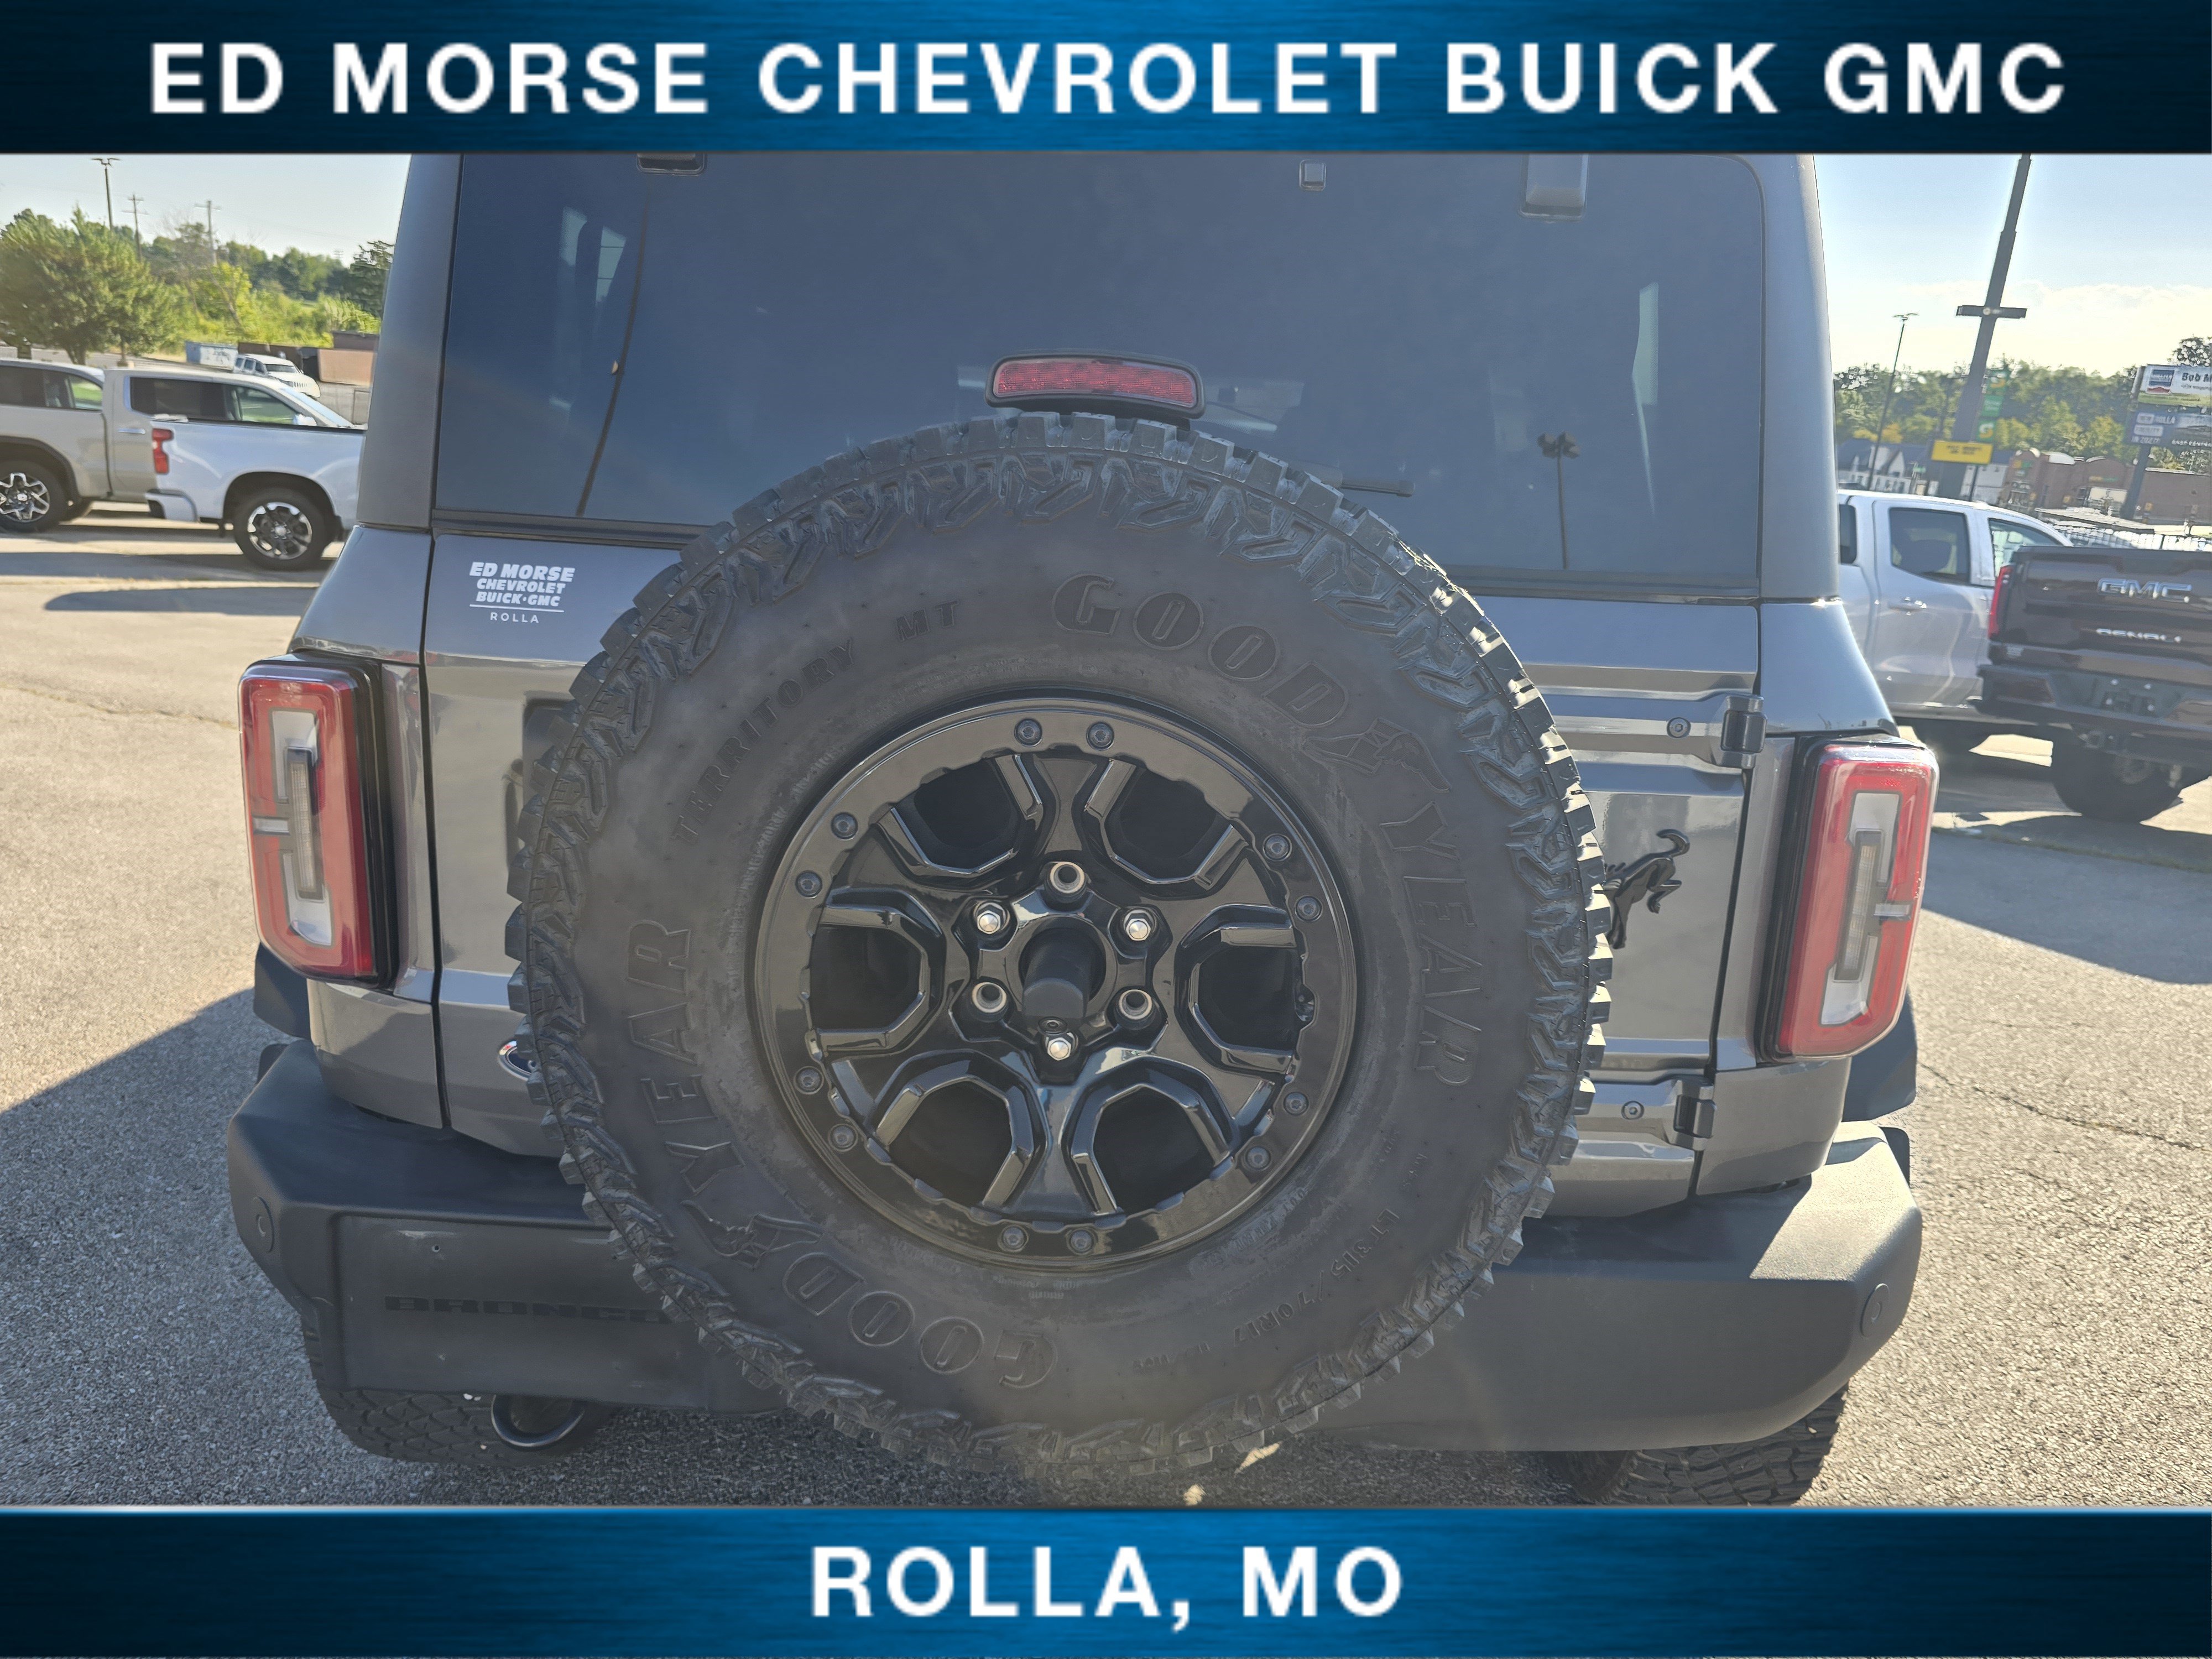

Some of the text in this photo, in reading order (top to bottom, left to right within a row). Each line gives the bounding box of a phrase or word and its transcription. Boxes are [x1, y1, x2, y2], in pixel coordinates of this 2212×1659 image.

[469, 561, 576, 582] ED MORSE
[476, 578, 566, 594] CHEVROLET
[2098, 577, 2192, 603] GMC
[490, 611, 539, 623] ROLLA
[671, 638, 854, 846] TERRITORY
[895, 599, 960, 642] MT
[1052, 573, 1484, 1086] GOODYEAR
[627, 920, 1058, 1389] GOODYEAR
